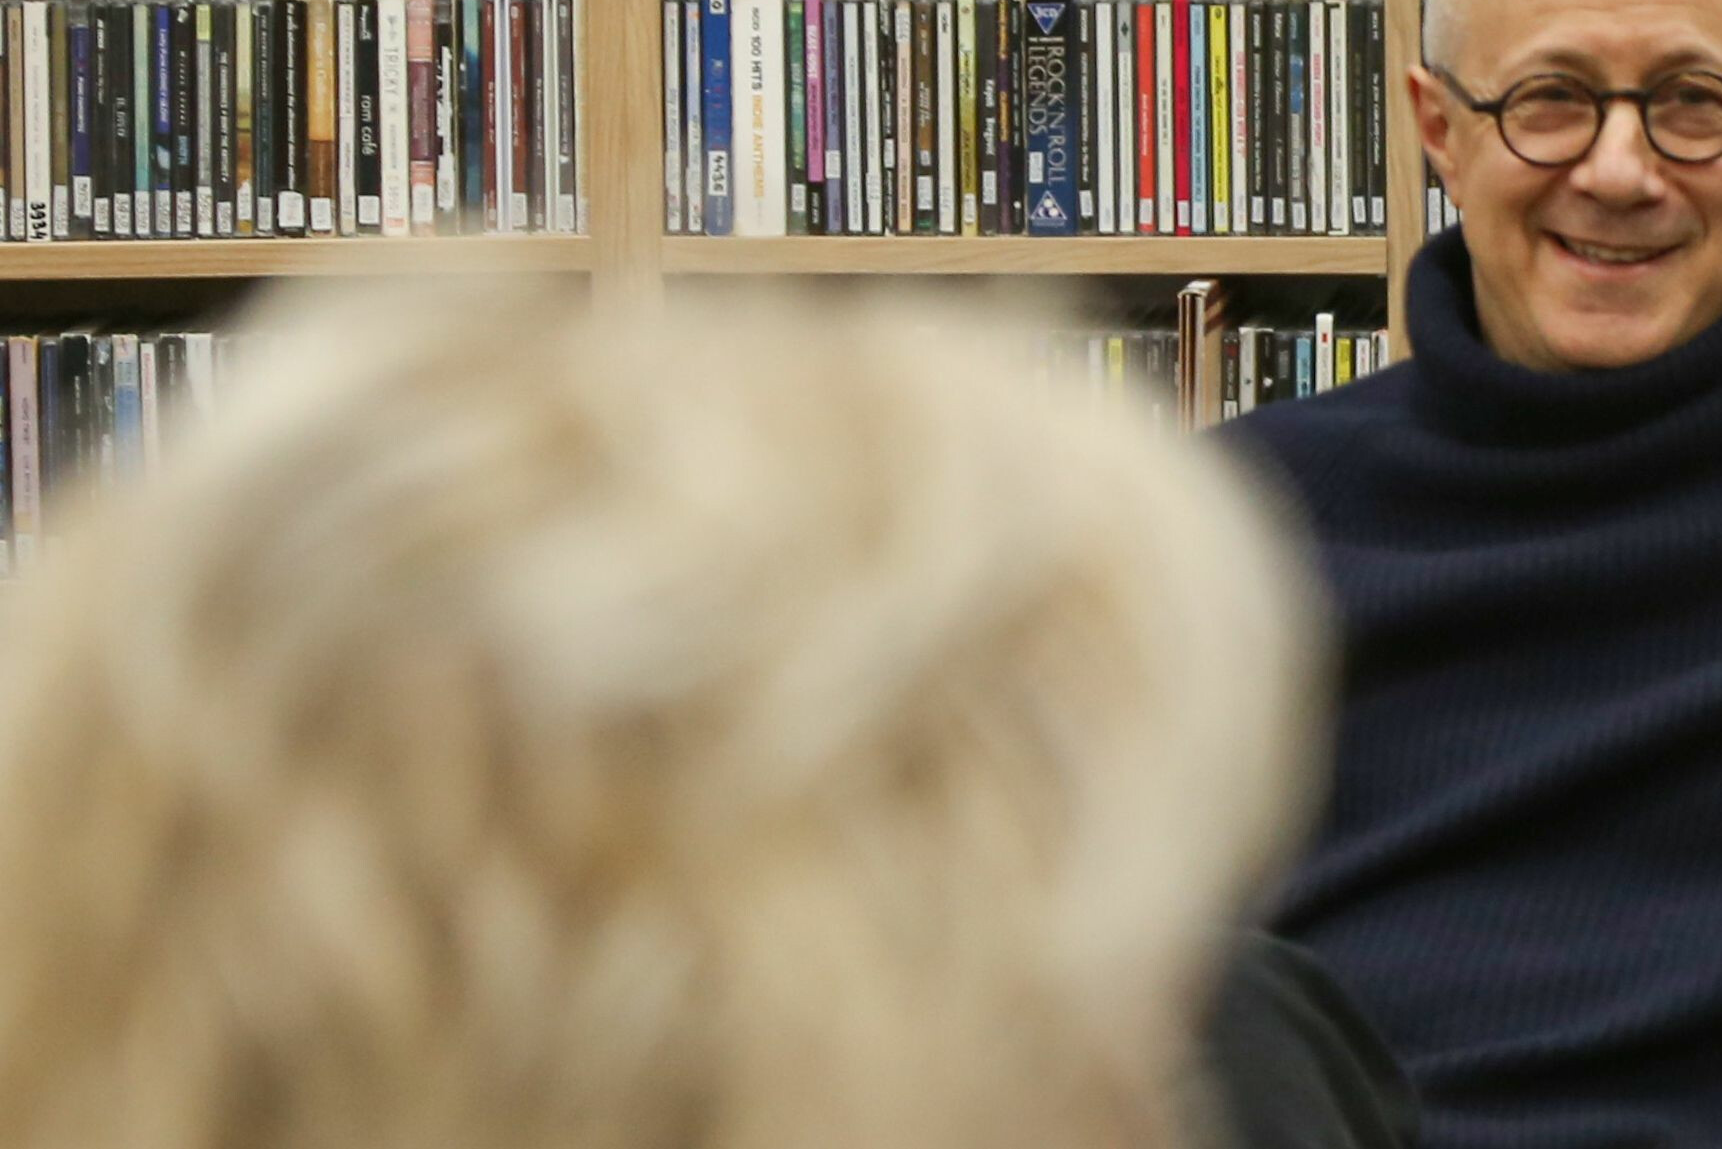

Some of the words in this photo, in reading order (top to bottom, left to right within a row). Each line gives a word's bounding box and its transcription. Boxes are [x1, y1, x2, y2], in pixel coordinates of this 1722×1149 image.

[750, 36, 762, 57] 100
[751, 60, 763, 90] HITS
[1027, 46, 1048, 135] LEGENDS
[360, 95, 372, 122] ram
[752, 94, 763, 129] INDIE
[1046, 45, 1067, 187] ROCK'N'ROLL
[361, 126, 377, 155] café
[752, 134, 764, 198] ANTHEMS
[30, 201, 46, 240] 3934
